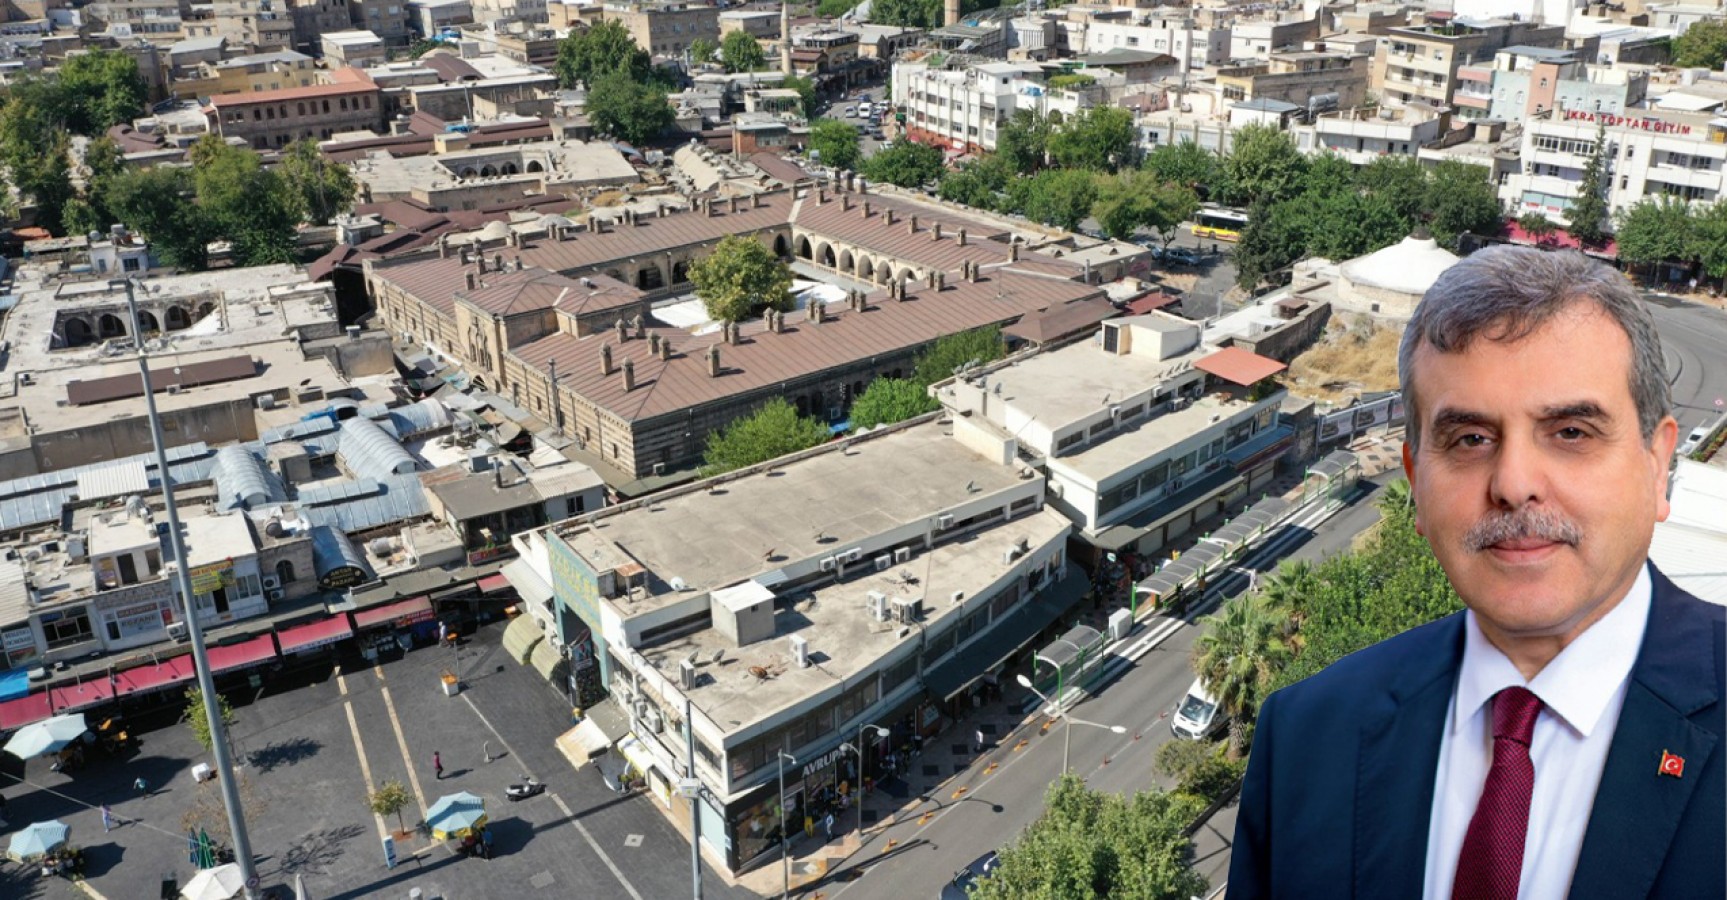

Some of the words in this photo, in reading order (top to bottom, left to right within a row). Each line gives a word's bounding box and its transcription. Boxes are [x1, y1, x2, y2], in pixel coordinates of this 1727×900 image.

[1566, 109, 1595, 122] İKRA
[1601, 114, 1650, 130] TOPTAN
[1654, 120, 1691, 134] GİYİM
